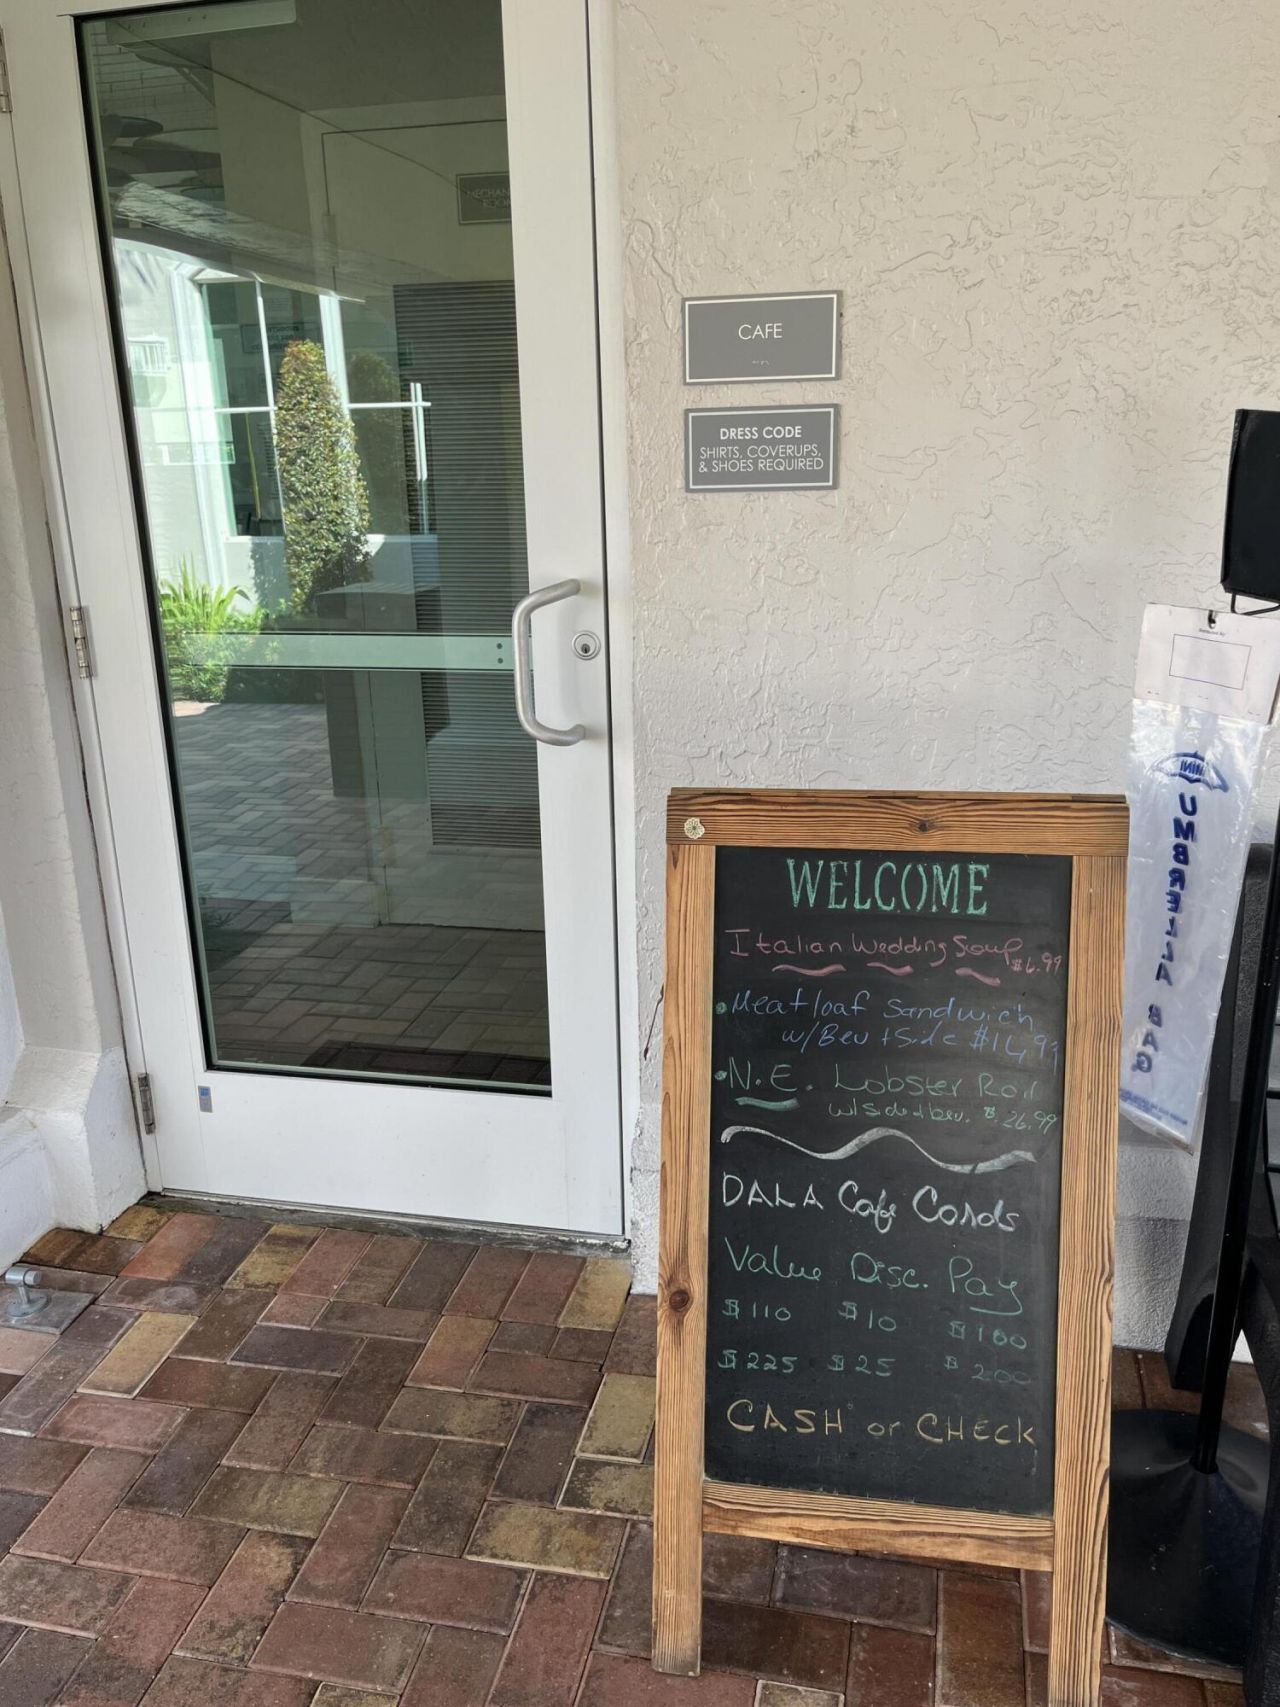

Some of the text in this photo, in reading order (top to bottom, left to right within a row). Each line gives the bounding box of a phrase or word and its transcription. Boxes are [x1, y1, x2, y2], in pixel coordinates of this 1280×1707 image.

[738, 322, 783, 340] CAFE
[720, 425, 802, 440] DRESS CODE
[698, 458, 824, 473] & SHOES REQUIRED
[700, 444, 822, 459] SHIRTS, COVERUPS,
[786, 857, 990, 915] WELCOME
[725, 928, 843, 957] Italian
[851, 932, 948, 968] Wedding
[952, 934, 1024, 966] Soup
[882, 996, 1034, 1032] Sandwich
[834, 1063, 962, 1098] Lobster
[724, 1237, 823, 1282] Value
[949, 1255, 1024, 1316] Pay
[726, 1399, 1037, 1446] CASH or CHECK
